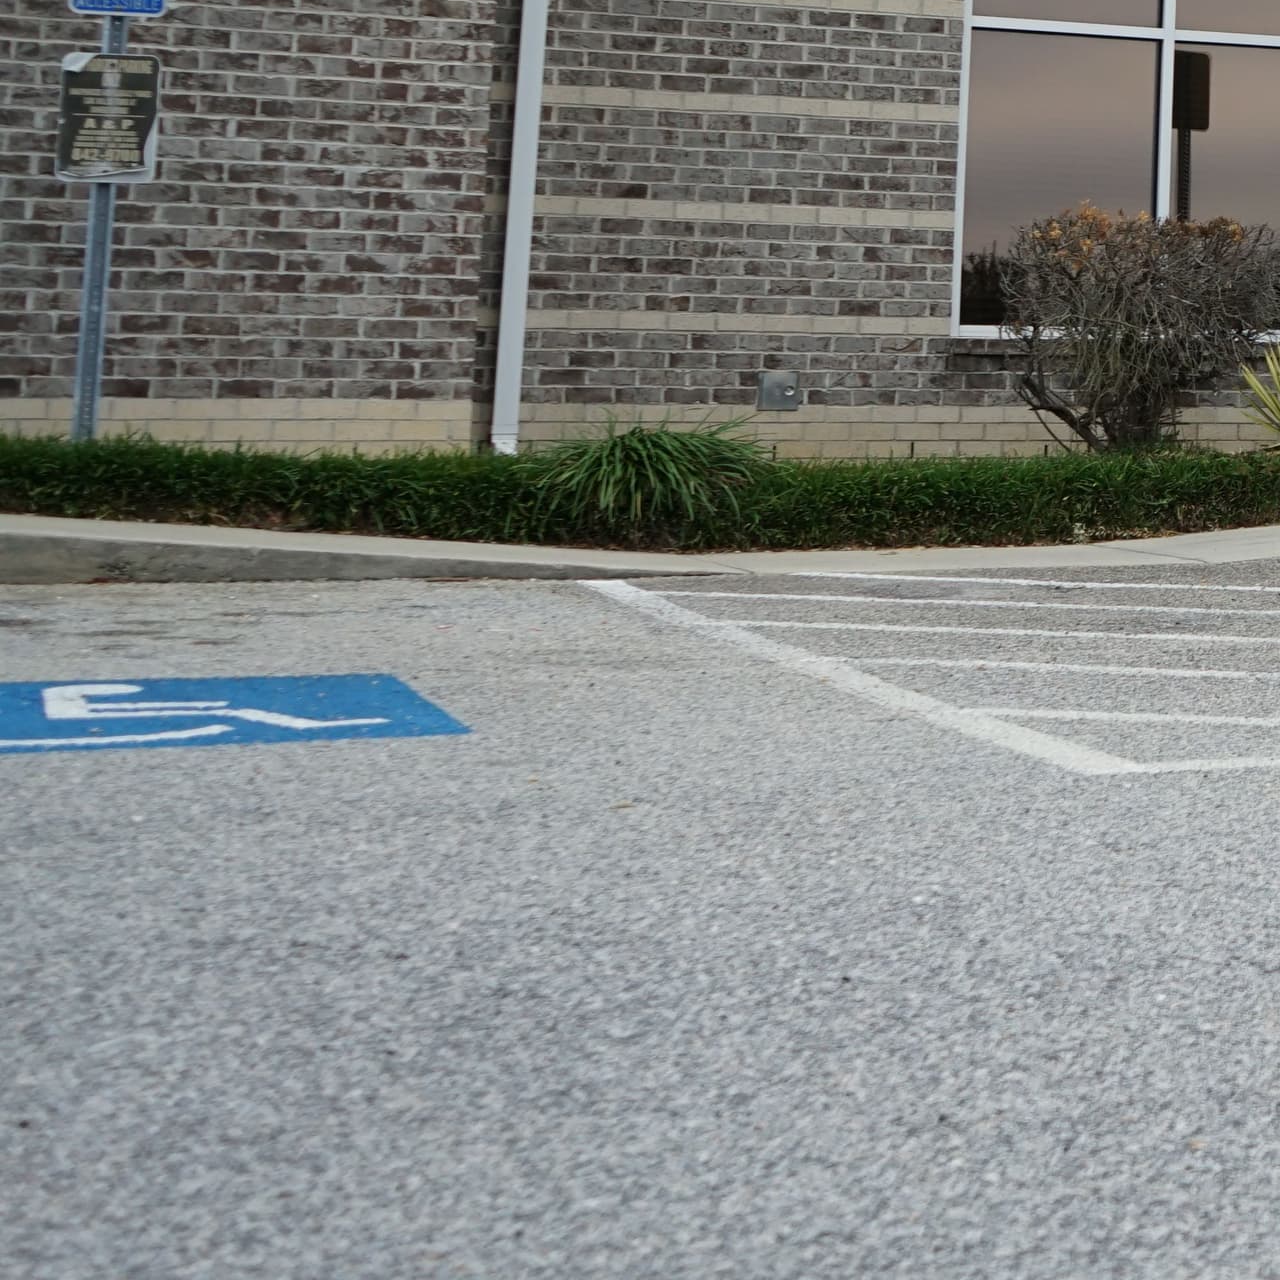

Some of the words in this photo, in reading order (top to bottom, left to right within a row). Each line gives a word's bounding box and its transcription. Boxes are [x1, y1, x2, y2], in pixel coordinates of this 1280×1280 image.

[83, 118, 97, 129] A
[102, 119, 117, 130] &
[120, 120, 135, 130] P
